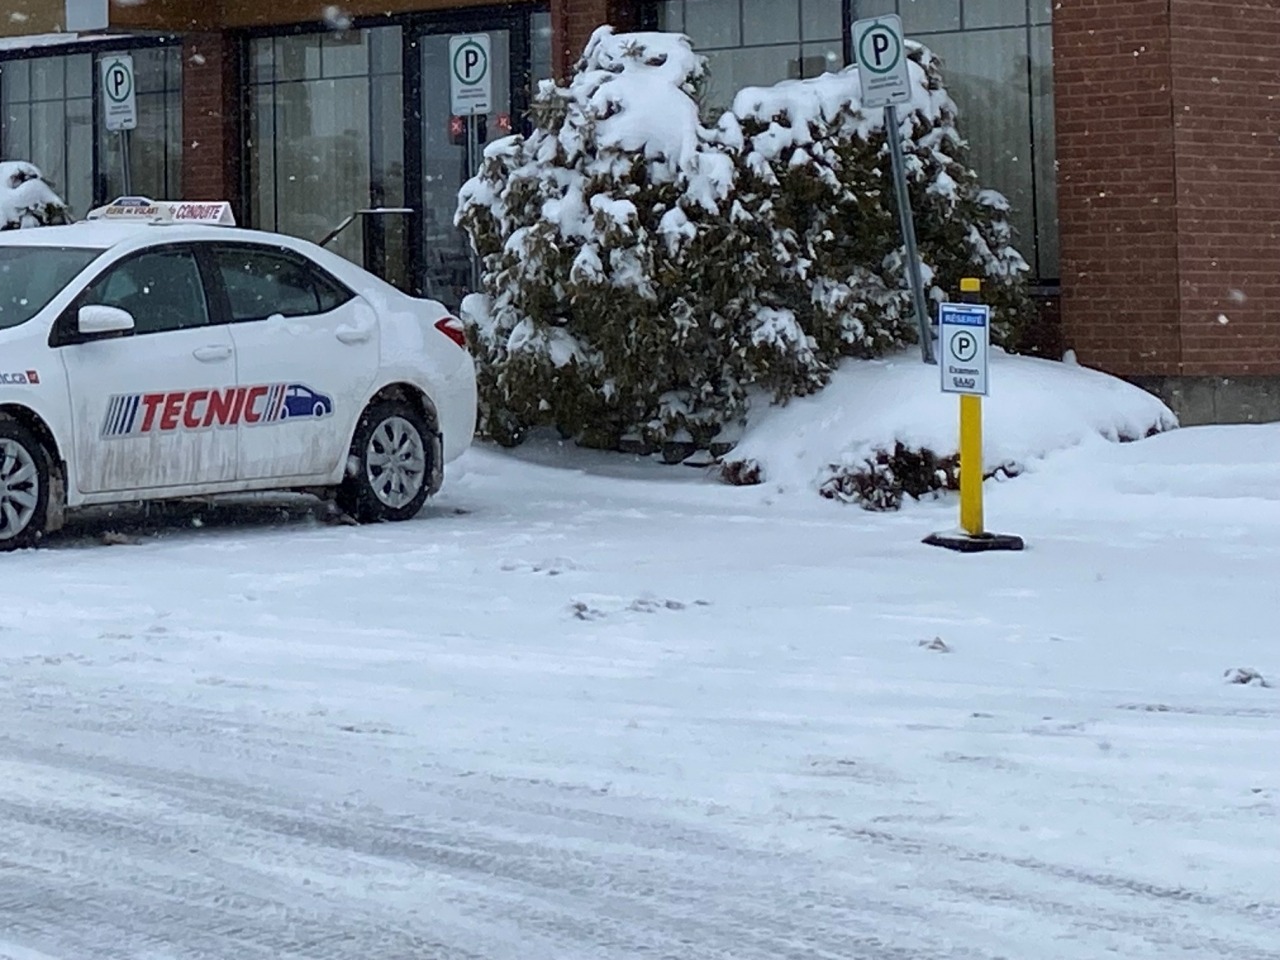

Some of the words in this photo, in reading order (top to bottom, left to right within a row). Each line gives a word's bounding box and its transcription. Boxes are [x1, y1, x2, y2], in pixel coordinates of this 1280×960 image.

[871, 33, 889, 66] P
[465, 49, 478, 78] P
[114, 70, 124, 96] P
[176, 205, 222, 219] CONDUITE
[945, 313, 983, 325] RÉSERVÉ
[958, 337, 970, 355] P
[949, 365, 979, 375] Examen
[140, 386, 269, 432] TECNIC
